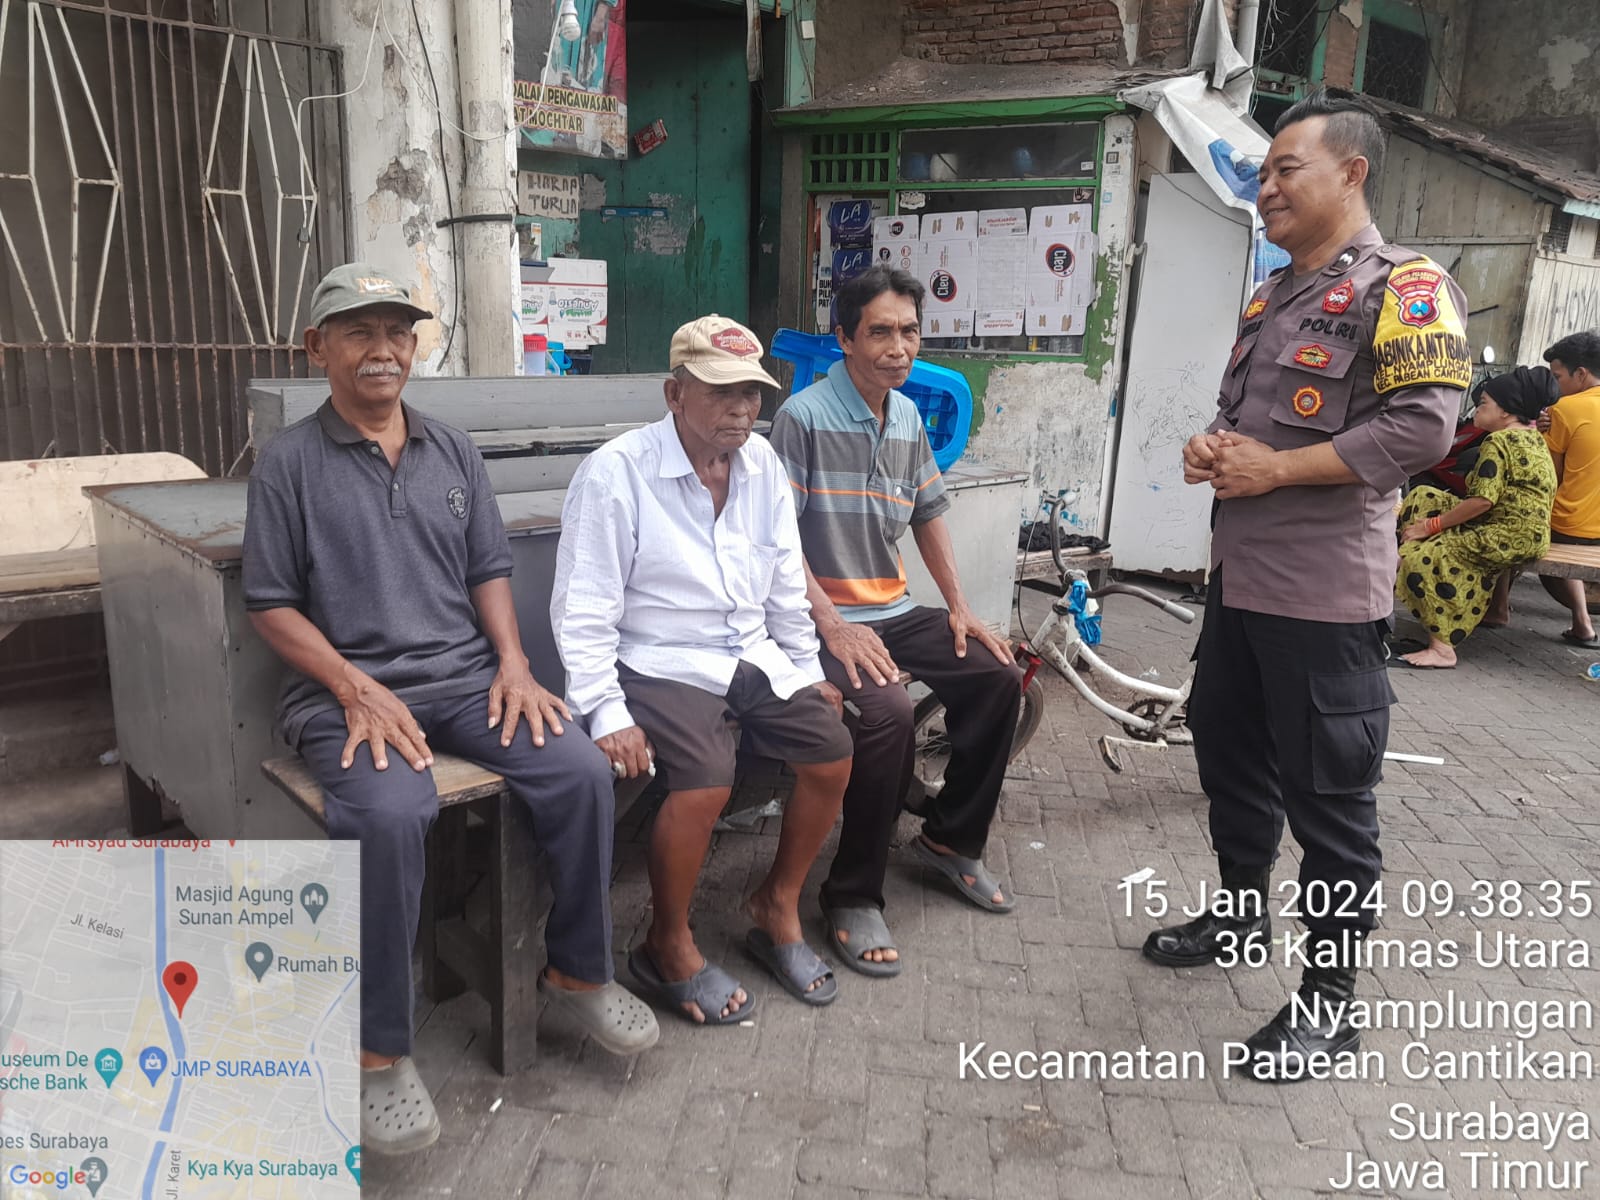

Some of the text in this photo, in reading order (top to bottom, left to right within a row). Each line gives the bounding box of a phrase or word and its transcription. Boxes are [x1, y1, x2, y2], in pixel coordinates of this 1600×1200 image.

[548, 87, 617, 113] PENGAWASAN
[529, 109, 583, 132] MOCHTAR
[527, 173, 577, 195] HARAP
[528, 194, 577, 214] TURUN
[840, 203, 862, 224] LA
[841, 252, 863, 272] LA
[1053, 250, 1067, 272] Cleo
[936, 275, 950, 296] Cleo
[1299, 317, 1358, 340] POLRI
[1394, 369, 1430, 384] PABEAN
